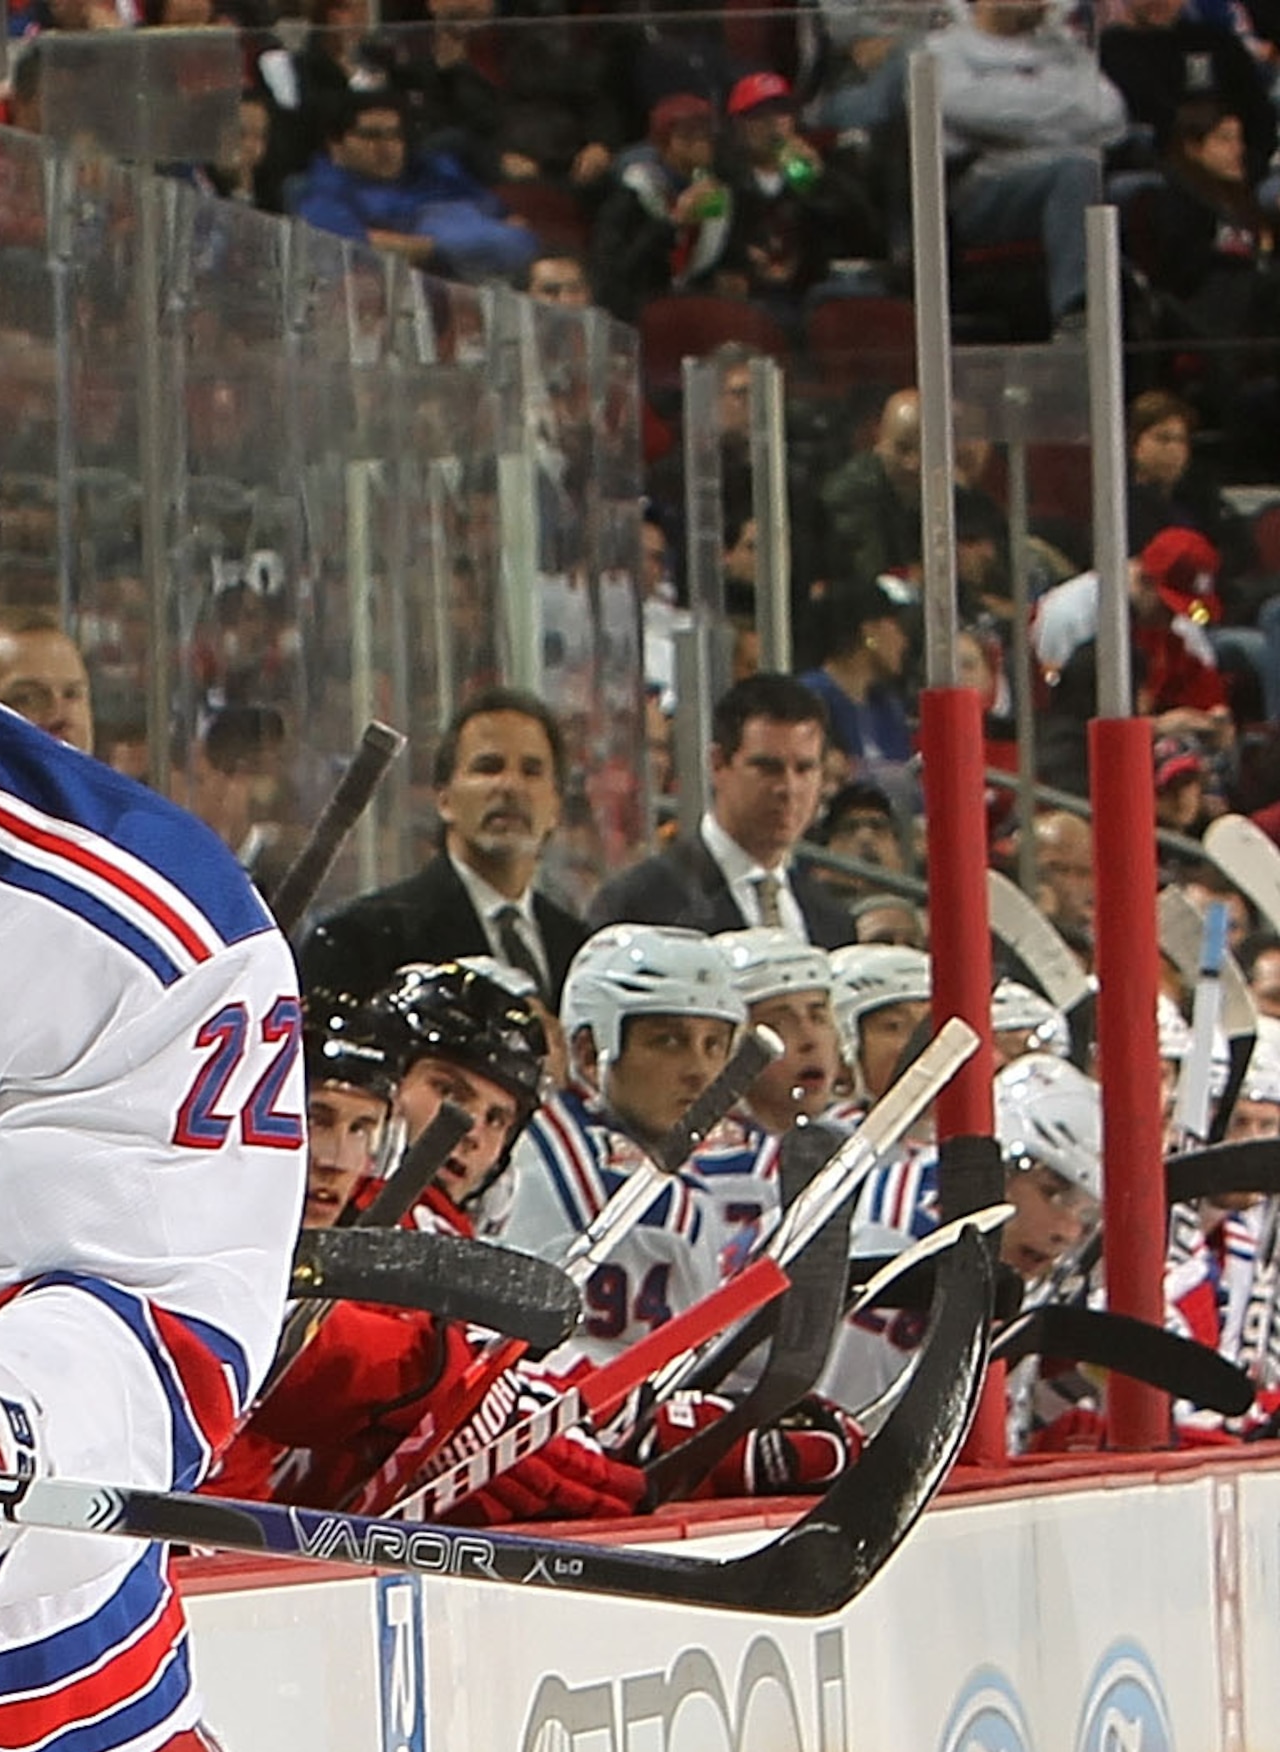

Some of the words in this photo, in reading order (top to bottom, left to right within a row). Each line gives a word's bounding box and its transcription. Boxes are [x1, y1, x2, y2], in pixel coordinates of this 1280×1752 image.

[171, 996, 304, 1149] 22
[584, 1262, 674, 1341] 94
[288, 1505, 504, 1583] VAPOR
